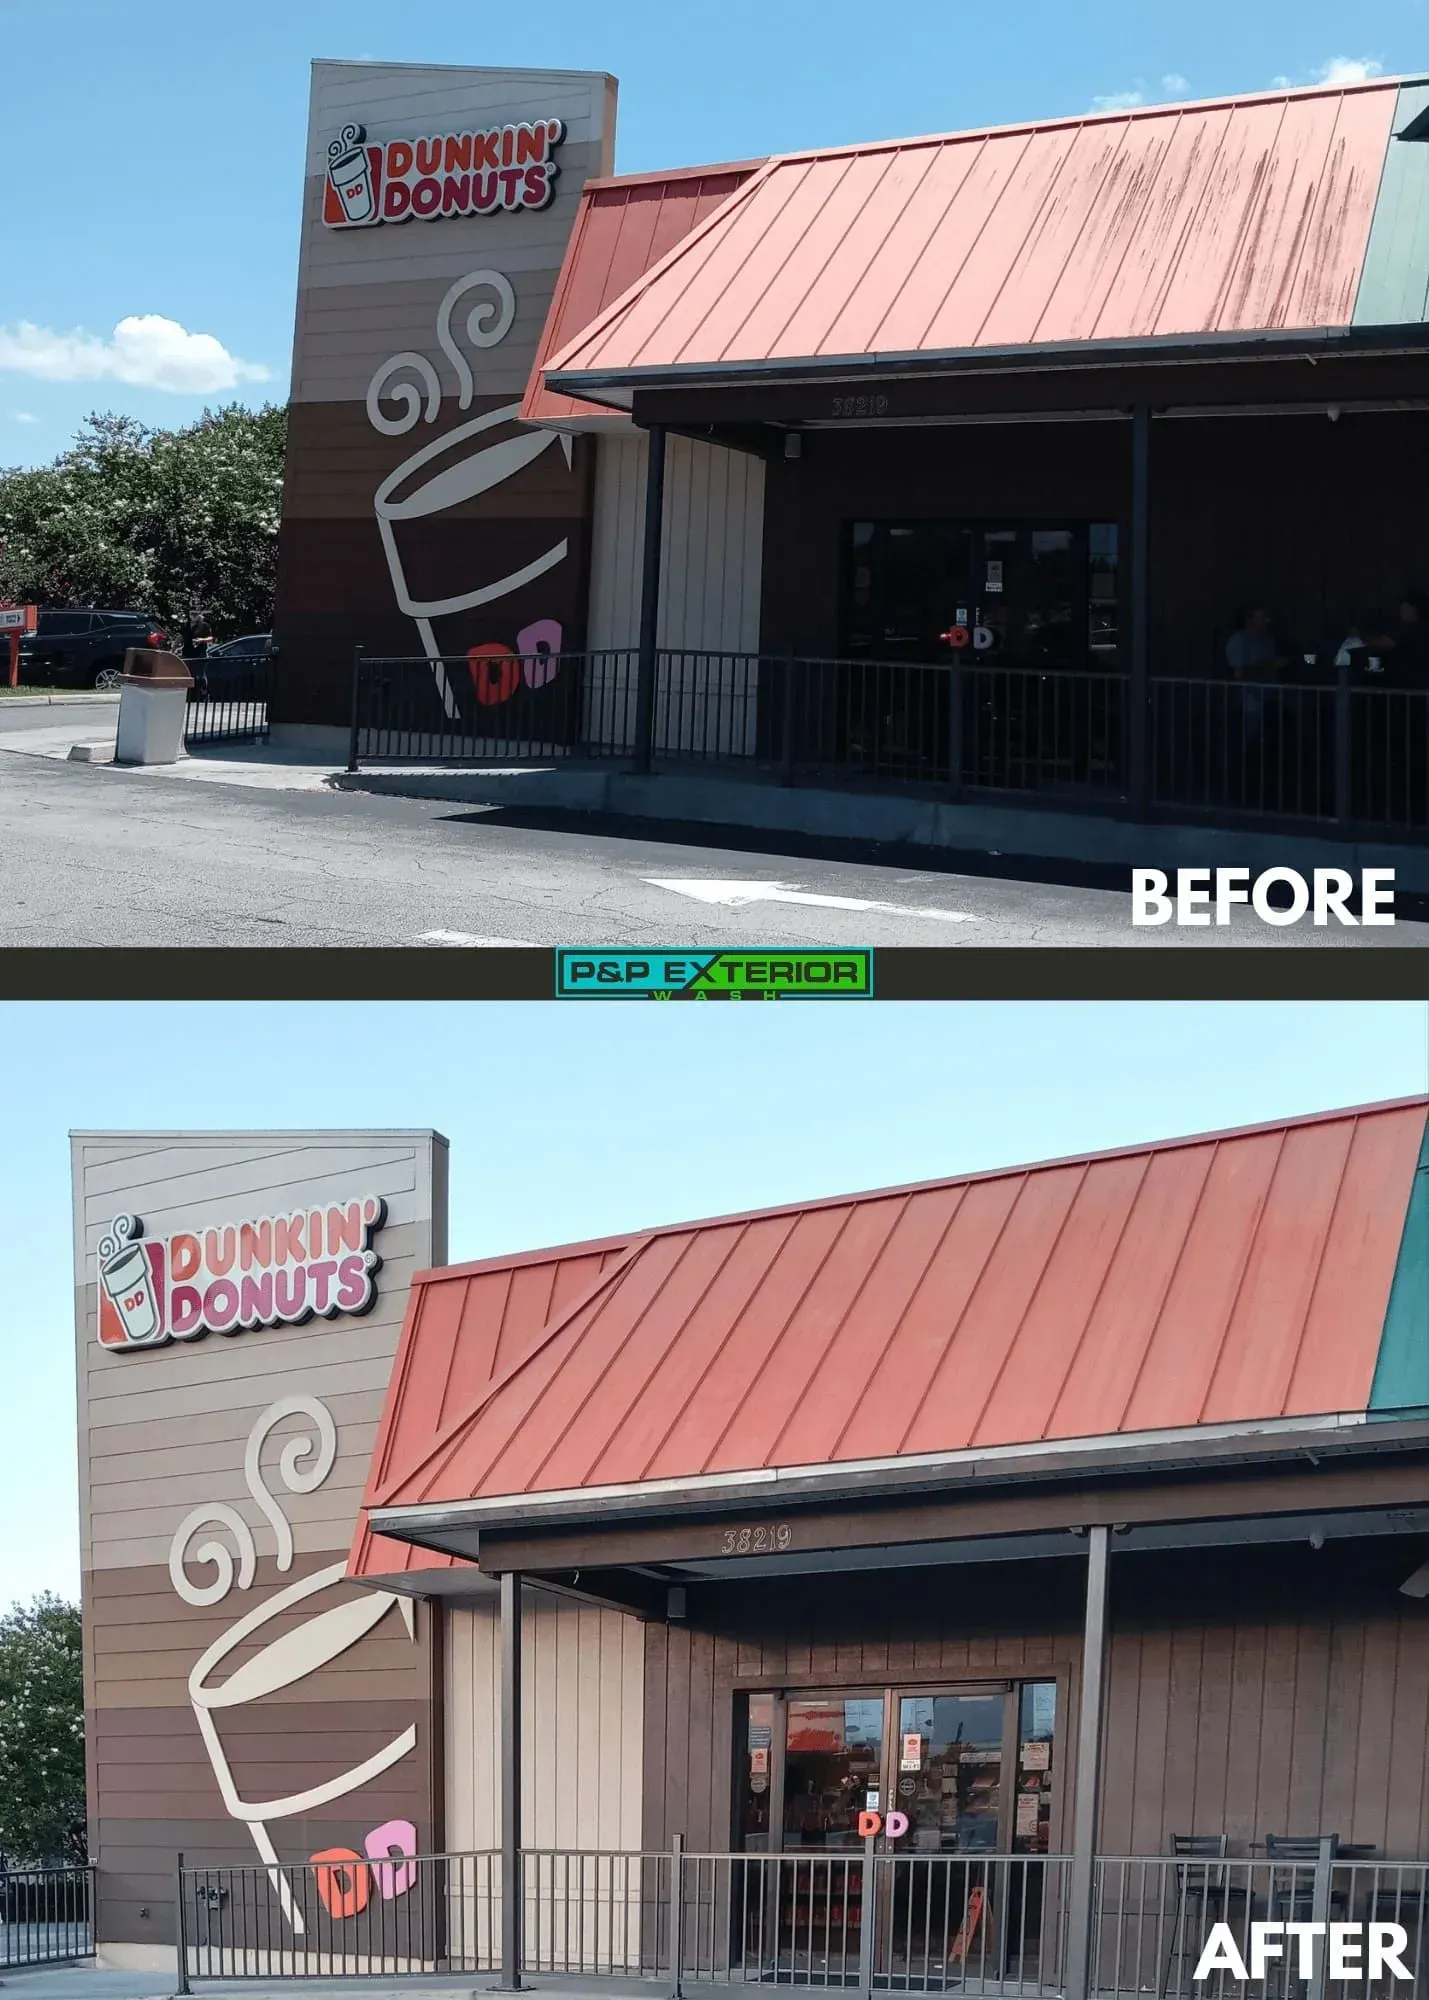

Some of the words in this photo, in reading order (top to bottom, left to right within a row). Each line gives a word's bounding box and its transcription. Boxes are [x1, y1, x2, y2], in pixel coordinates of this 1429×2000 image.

[386, 122, 558, 179] DUNKIN'
[383, 165, 546, 218] DONUTS
[170, 1198, 376, 1283] DUNKIN'
[124, 1290, 145, 1312] DD
[170, 1255, 365, 1333] DONUTS
[721, 1524, 792, 1554] 38219
[858, 1810, 909, 1838] DD
